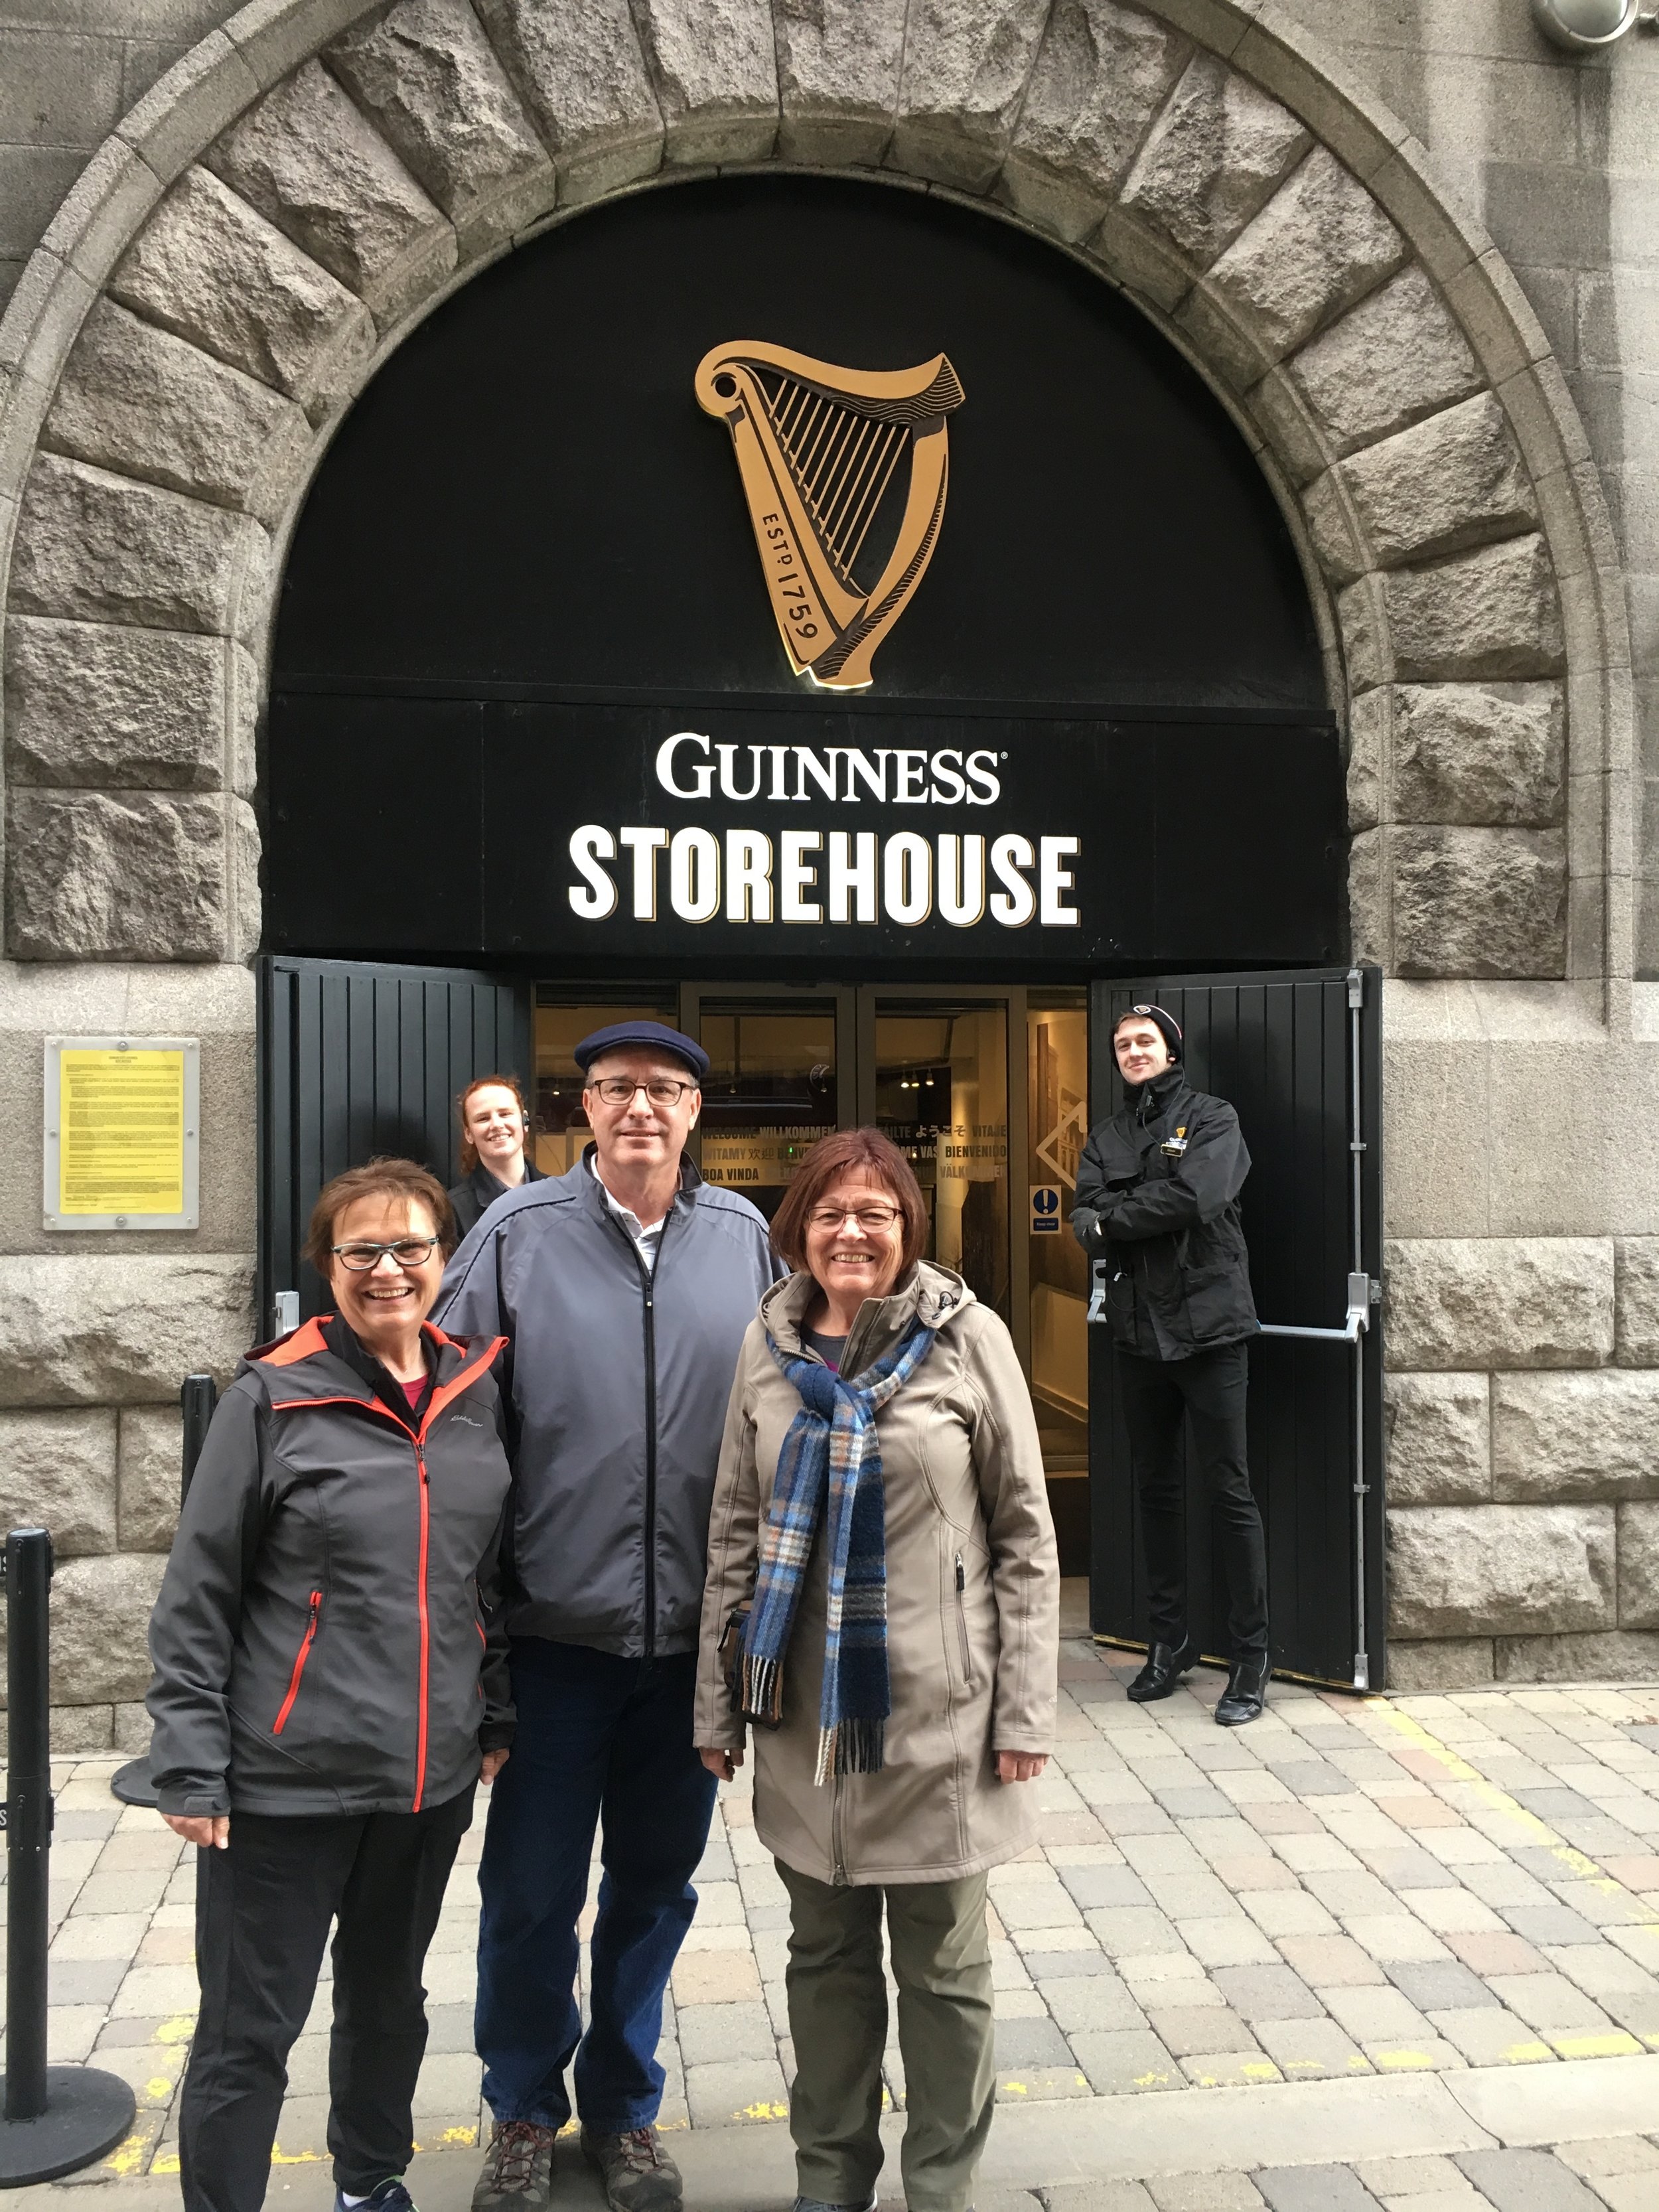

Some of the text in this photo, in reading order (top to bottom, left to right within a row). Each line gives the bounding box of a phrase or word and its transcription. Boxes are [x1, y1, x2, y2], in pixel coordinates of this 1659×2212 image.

[778, 573, 819, 640] 1759
[568, 824, 1081, 928] STOREHOUSE
[702, 1127, 757, 1140] WELCOME
[916, 1124, 966, 1138] ようこそ
[703, 1147, 746, 1160] WITAMY
[749, 1147, 774, 1160] 欢迎
[945, 1145, 1007, 1158] BIENVENIDO
[703, 1168, 759, 1181] BOA VINDA
